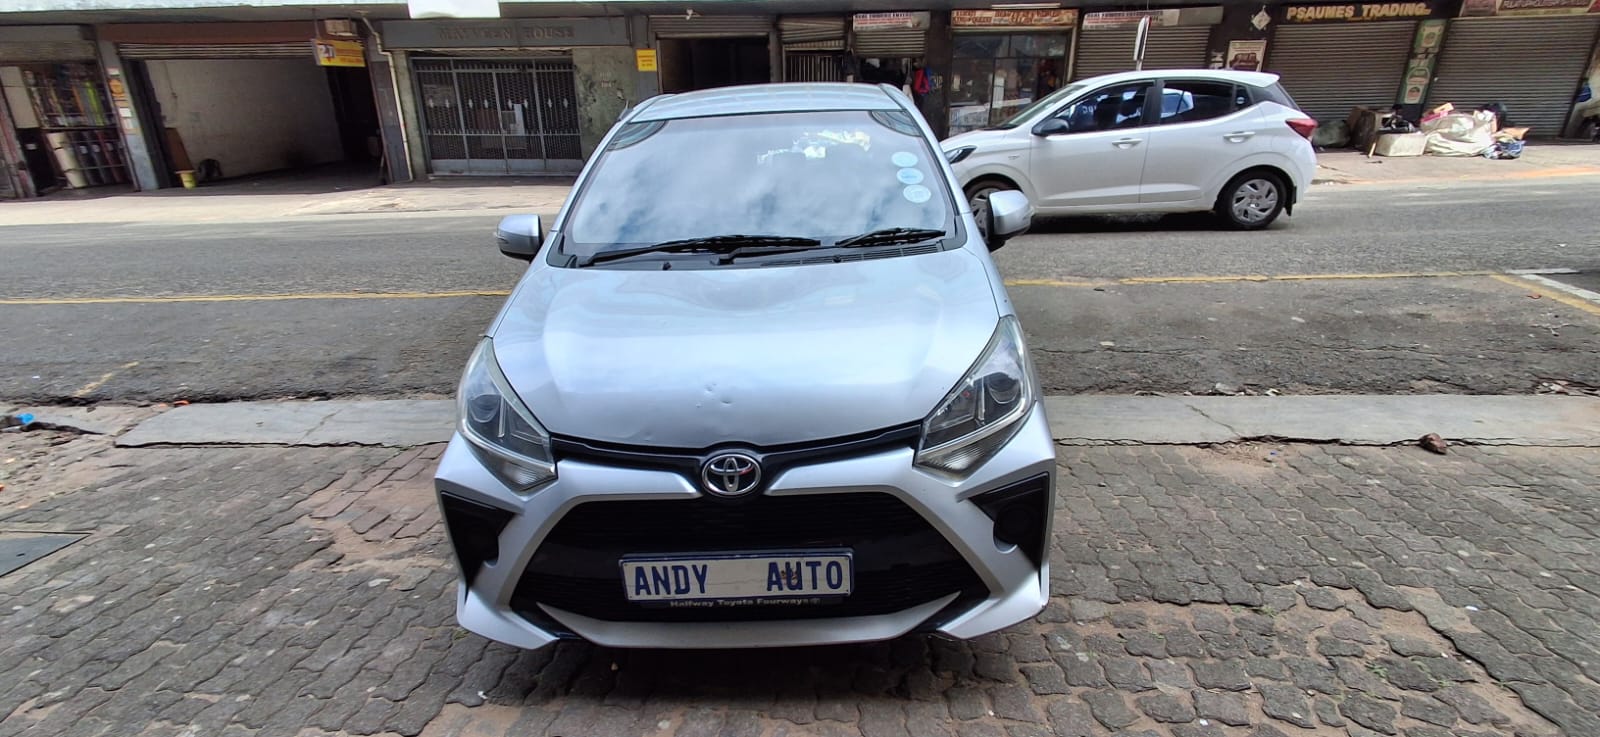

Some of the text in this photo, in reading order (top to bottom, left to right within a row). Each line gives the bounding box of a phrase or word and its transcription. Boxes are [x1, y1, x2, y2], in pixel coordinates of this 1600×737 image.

[1286, 5, 1355, 20] PSAUMES
[1361, 2, 1427, 17] TRADING
[634, 560, 843, 596] ANDY AUTO
[670, 597, 809, 609] Halfway Toyota Fourways
